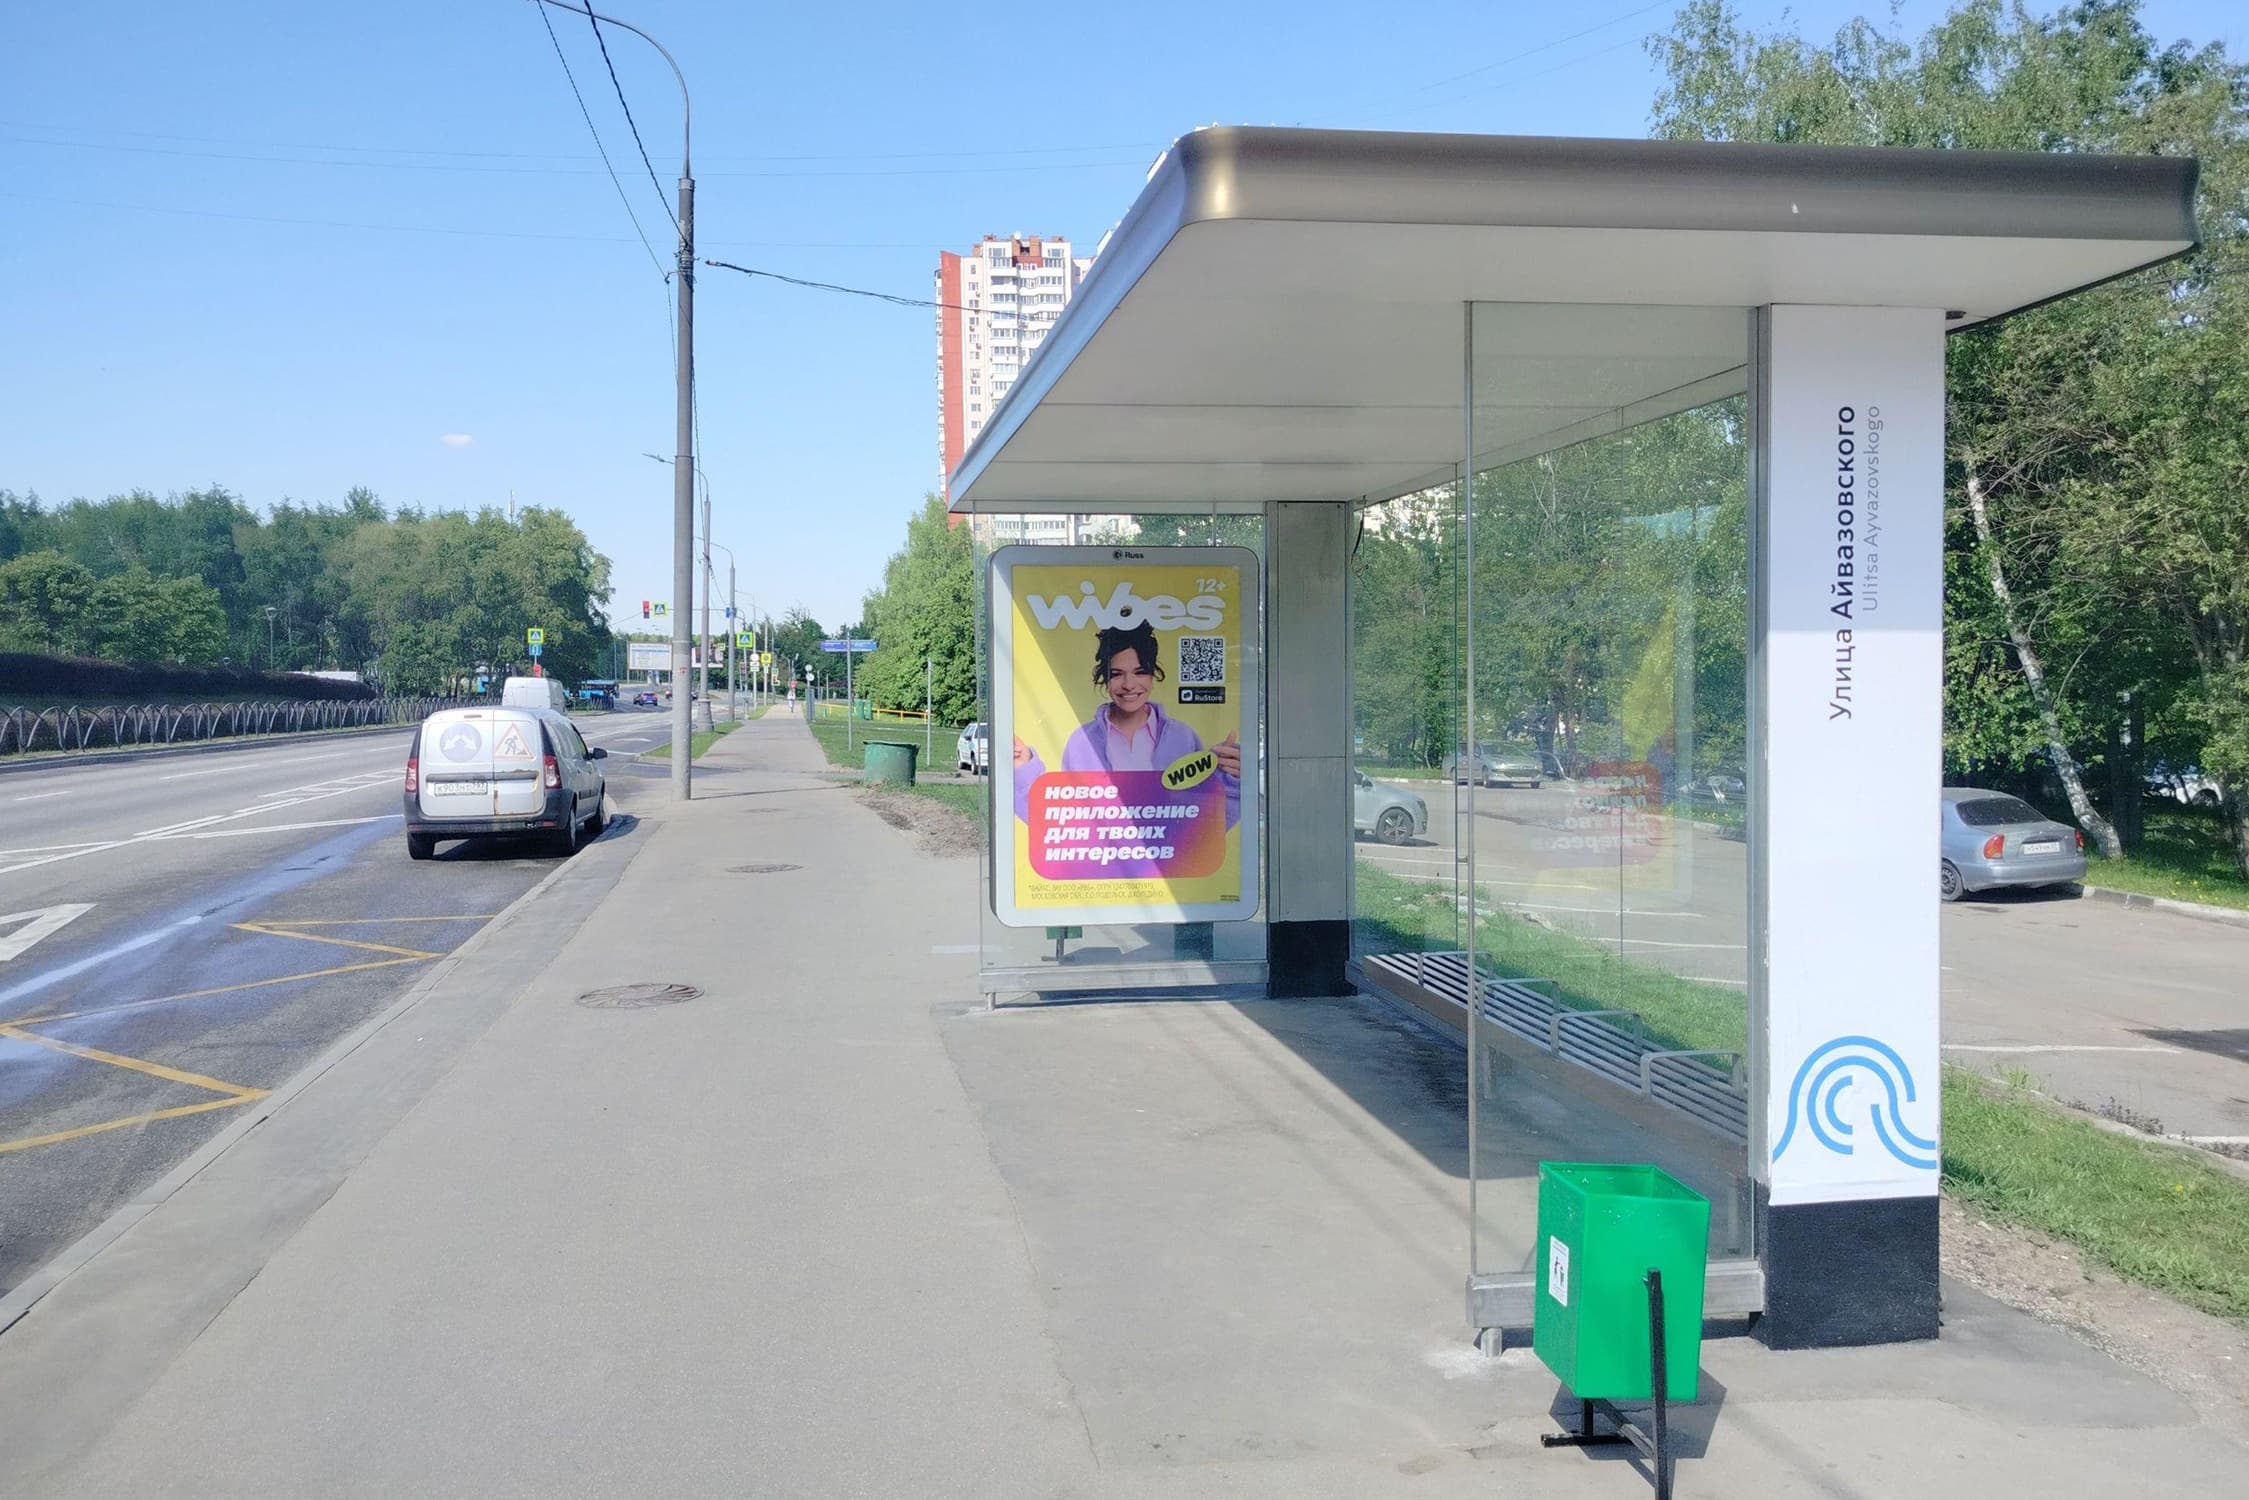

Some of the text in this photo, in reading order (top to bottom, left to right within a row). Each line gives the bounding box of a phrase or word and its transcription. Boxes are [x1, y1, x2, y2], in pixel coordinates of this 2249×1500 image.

[1862, 405, 1884, 611] Ulitsa Ayvazovskogo
[1124, 551, 1144, 559] Russ
[1829, 405, 1856, 720] Улица Айвазовского
[1196, 578, 1226, 593] 12+
[1026, 581, 1226, 631] wibes
[1194, 694, 1224, 703] RuStore
[1044, 785, 1119, 799] новое
[1044, 805, 1200, 825] приложение
[1044, 825, 1167, 844] для твоих
[1045, 846, 1175, 865] интересов
